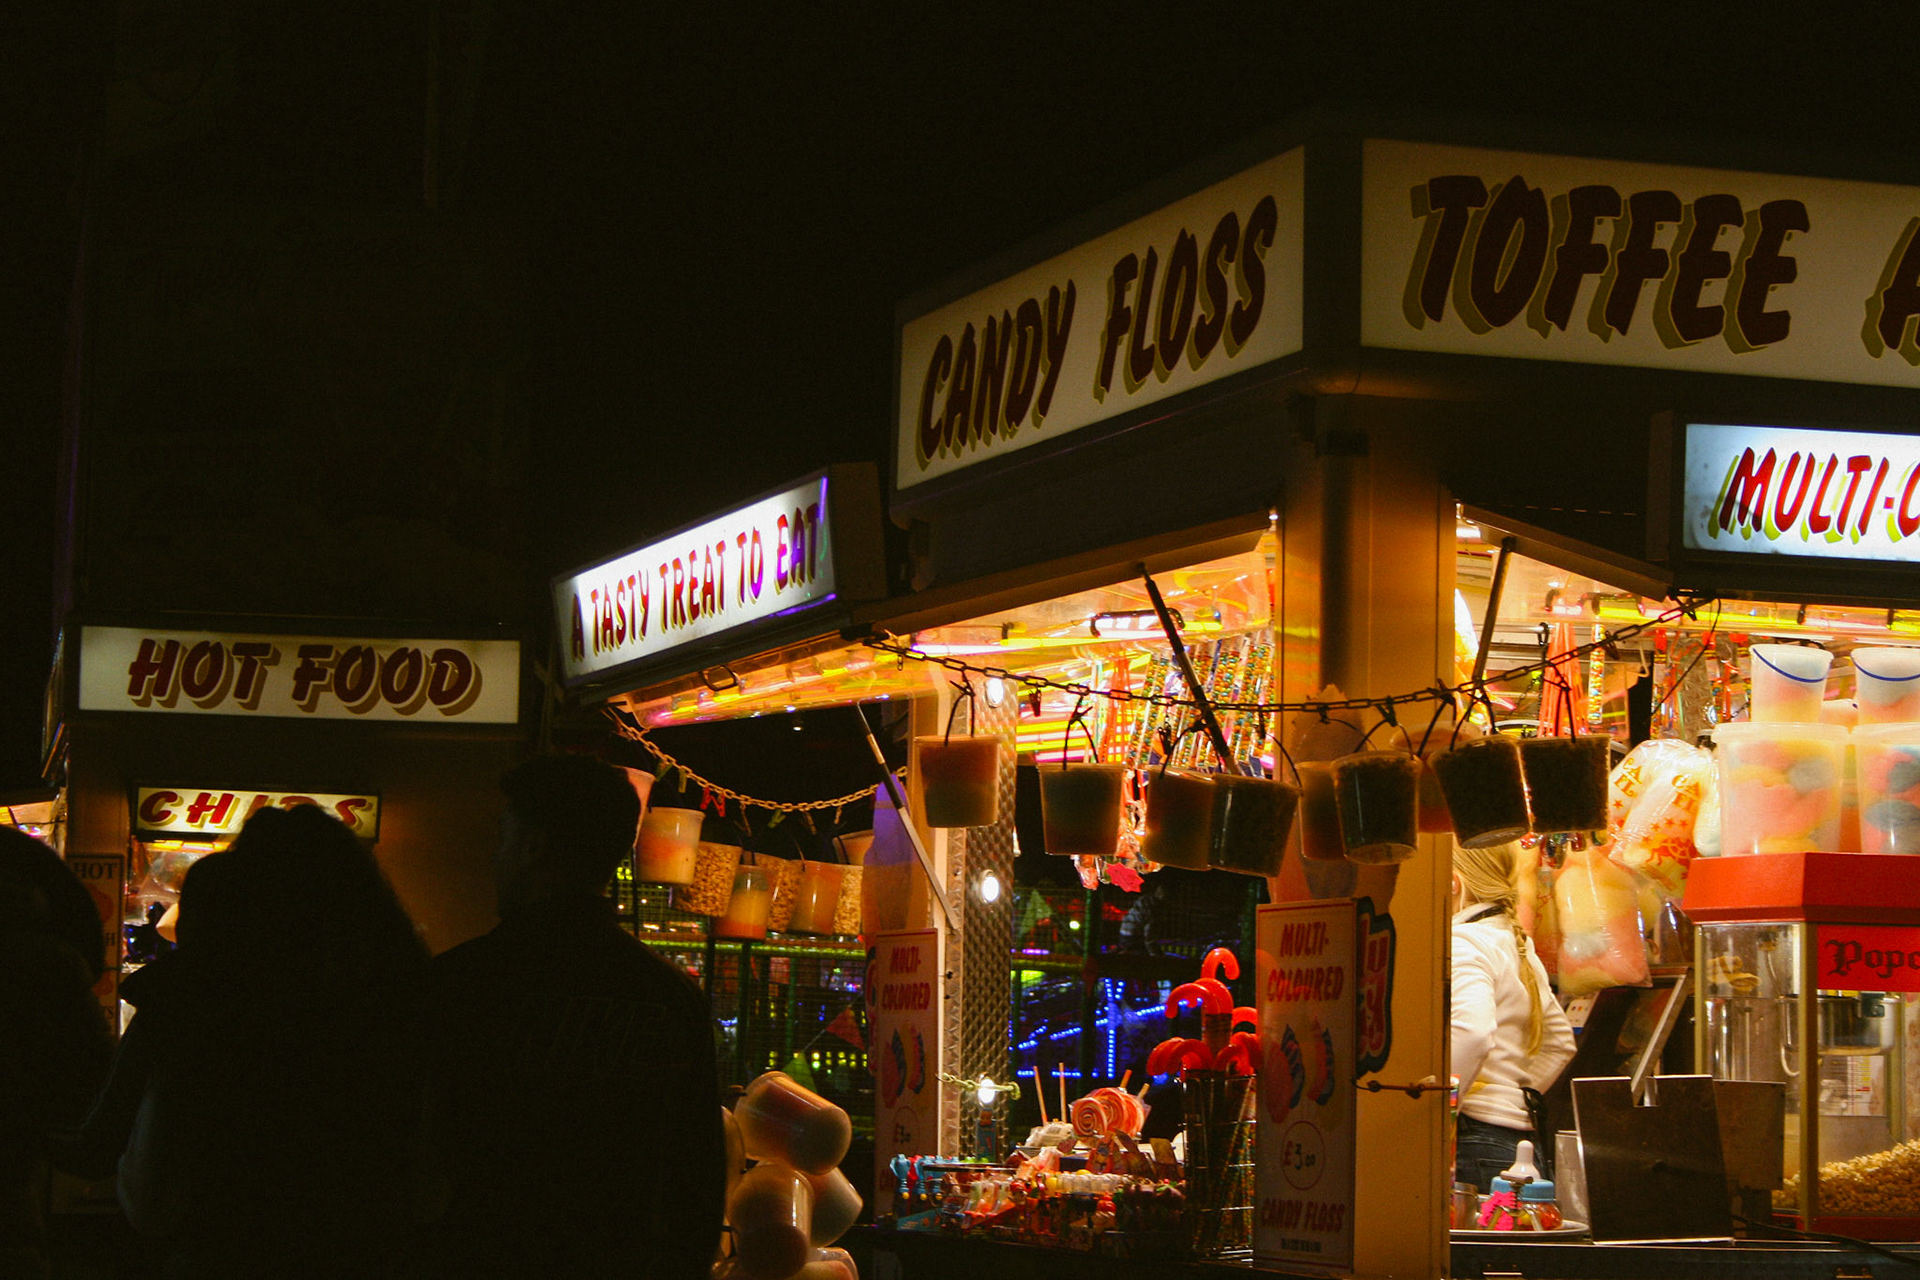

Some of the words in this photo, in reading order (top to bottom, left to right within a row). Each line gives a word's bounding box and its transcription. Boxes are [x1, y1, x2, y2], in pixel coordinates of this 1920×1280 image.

[1402, 175, 1810, 354] TOFFEE
[915, 279, 1076, 471] CANDY
[1093, 195, 1277, 404] FLOSS
[570, 593, 585, 662] A
[591, 569, 649, 657] TASTY
[659, 540, 726, 634] TREAT
[737, 526, 763, 608] TO
[774, 503, 820, 595] EAT
[127, 638, 280, 711] HOT
[292, 643, 483, 716] FOOD
[1279, 920, 1330, 957] MULTI-
[1266, 965, 1344, 1002] COLOURED
[1261, 1198, 1303, 1230] CANDY
[1304, 1200, 1345, 1233] FLOSS
